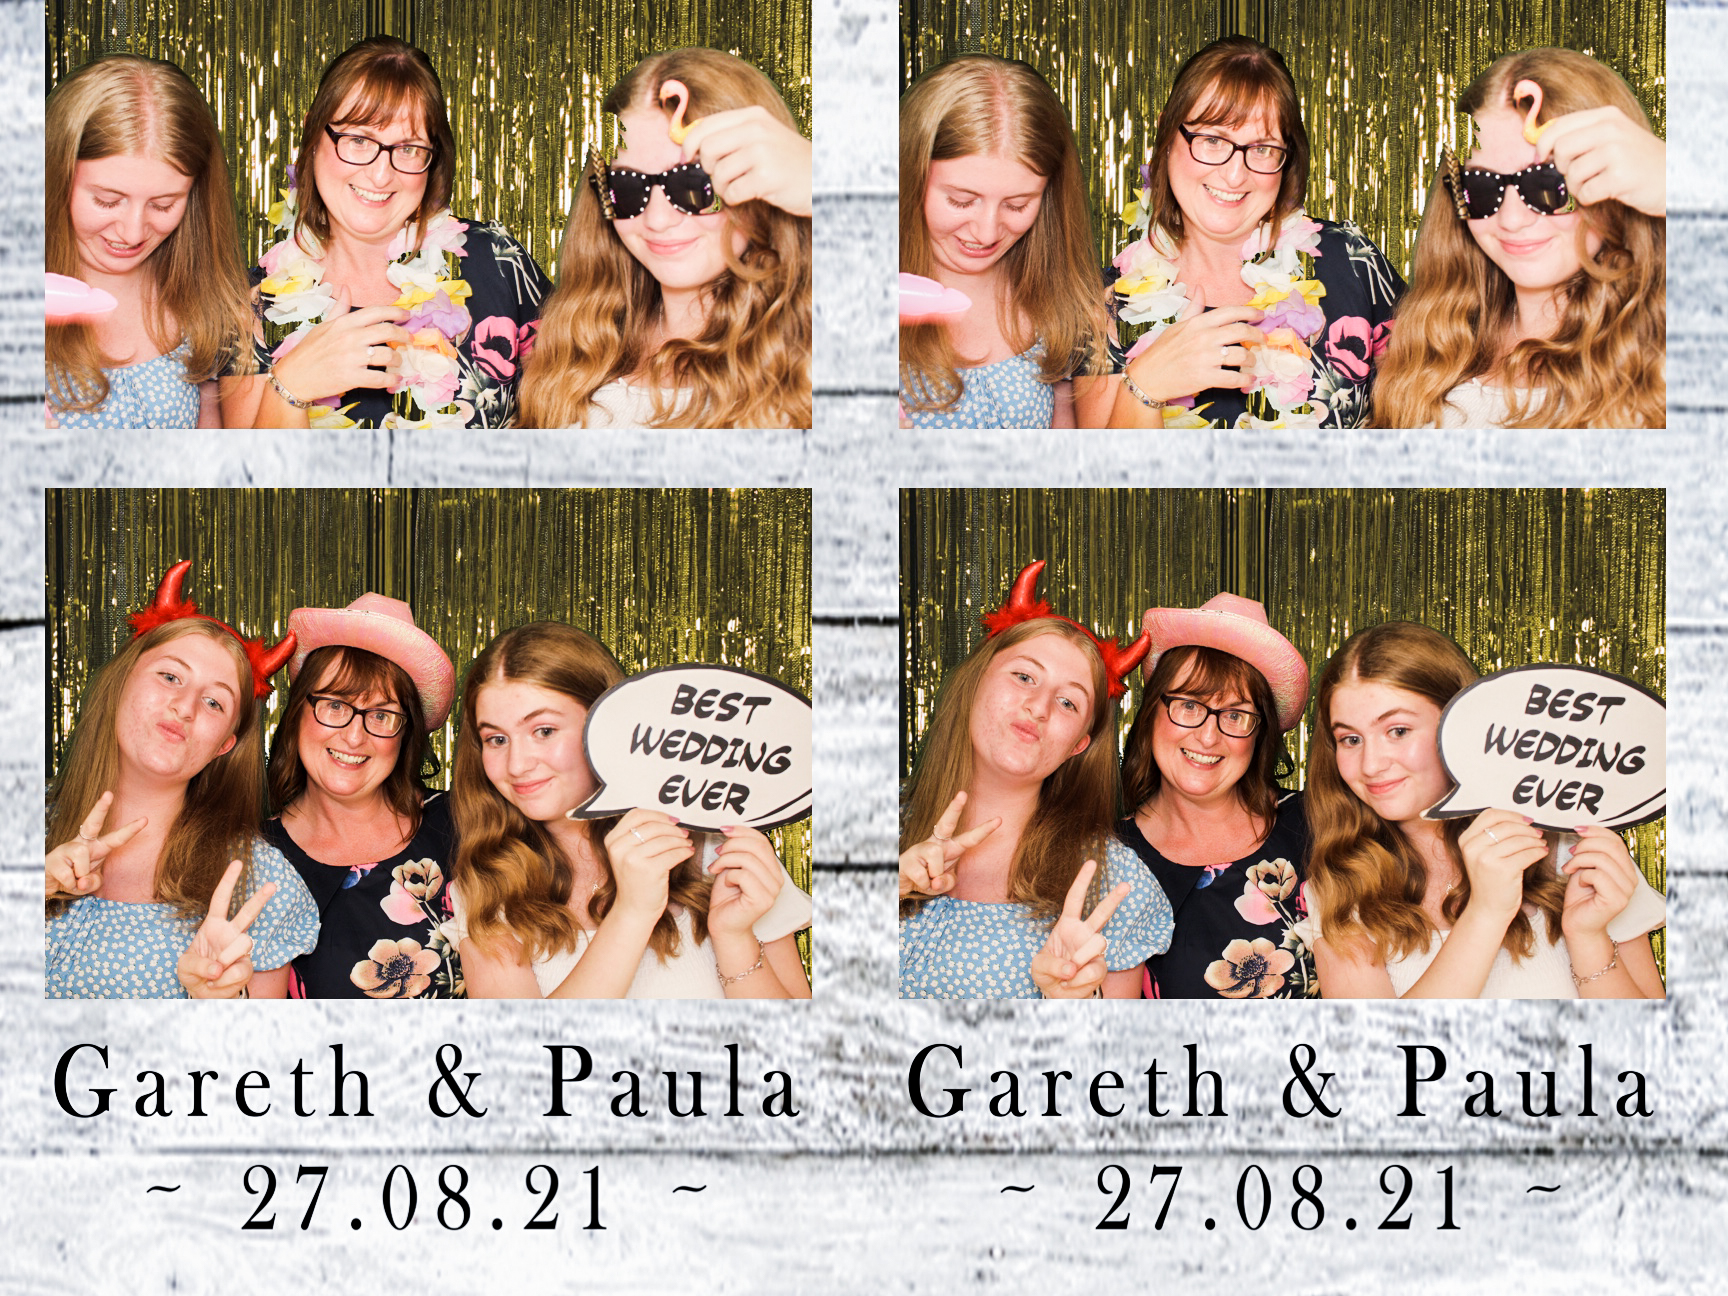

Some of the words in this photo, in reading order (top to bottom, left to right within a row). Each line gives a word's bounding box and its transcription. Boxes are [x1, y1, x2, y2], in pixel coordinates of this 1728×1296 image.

[671, 683, 772, 726] BEST
[1525, 683, 1626, 726] BEST
[630, 723, 793, 775] WEDDING
[1484, 723, 1647, 775] WEDDING
[658, 774, 751, 816] EVER
[1512, 774, 1605, 816] EVER
